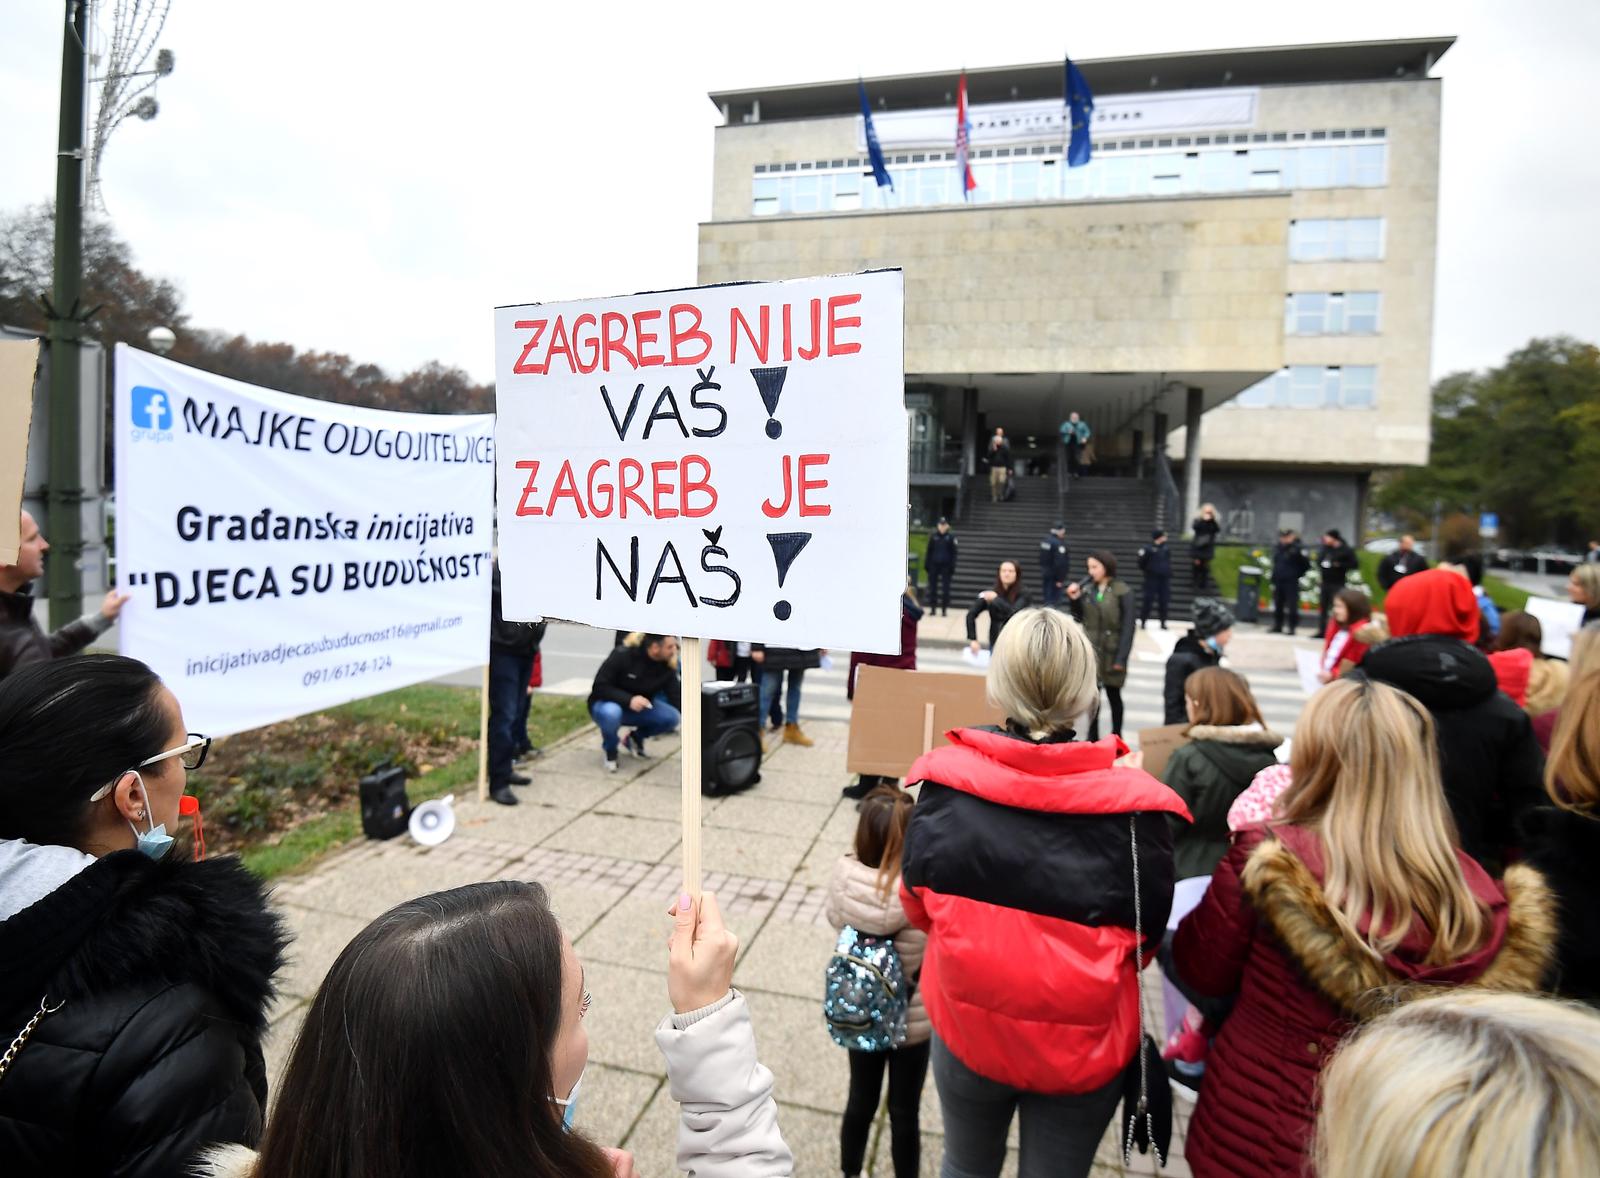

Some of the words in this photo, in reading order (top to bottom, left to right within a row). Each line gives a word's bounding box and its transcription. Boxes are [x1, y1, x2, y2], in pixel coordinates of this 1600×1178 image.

[513, 302, 713, 375] ZAGREB
[730, 294, 862, 364] NIJE
[183, 397, 316, 451] MAJKE
[324, 422, 492, 463] ODGOJITELJICE
[600, 365, 727, 442] VAŠ
[130, 428, 174, 443] grupa
[515, 455, 719, 519] ZAGREB
[762, 454, 831, 518] JE
[177, 506, 359, 542] Građanska
[367, 512, 473, 545] inicijativa
[128, 566, 280, 609] "DJECA
[291, 565, 333, 594] SU
[596, 525, 742, 608] NAŠ
[186, 615, 463, 676] inicijativadjecasubuducnost16@gmail.com
[303, 655, 393, 687] 091/6124-124
